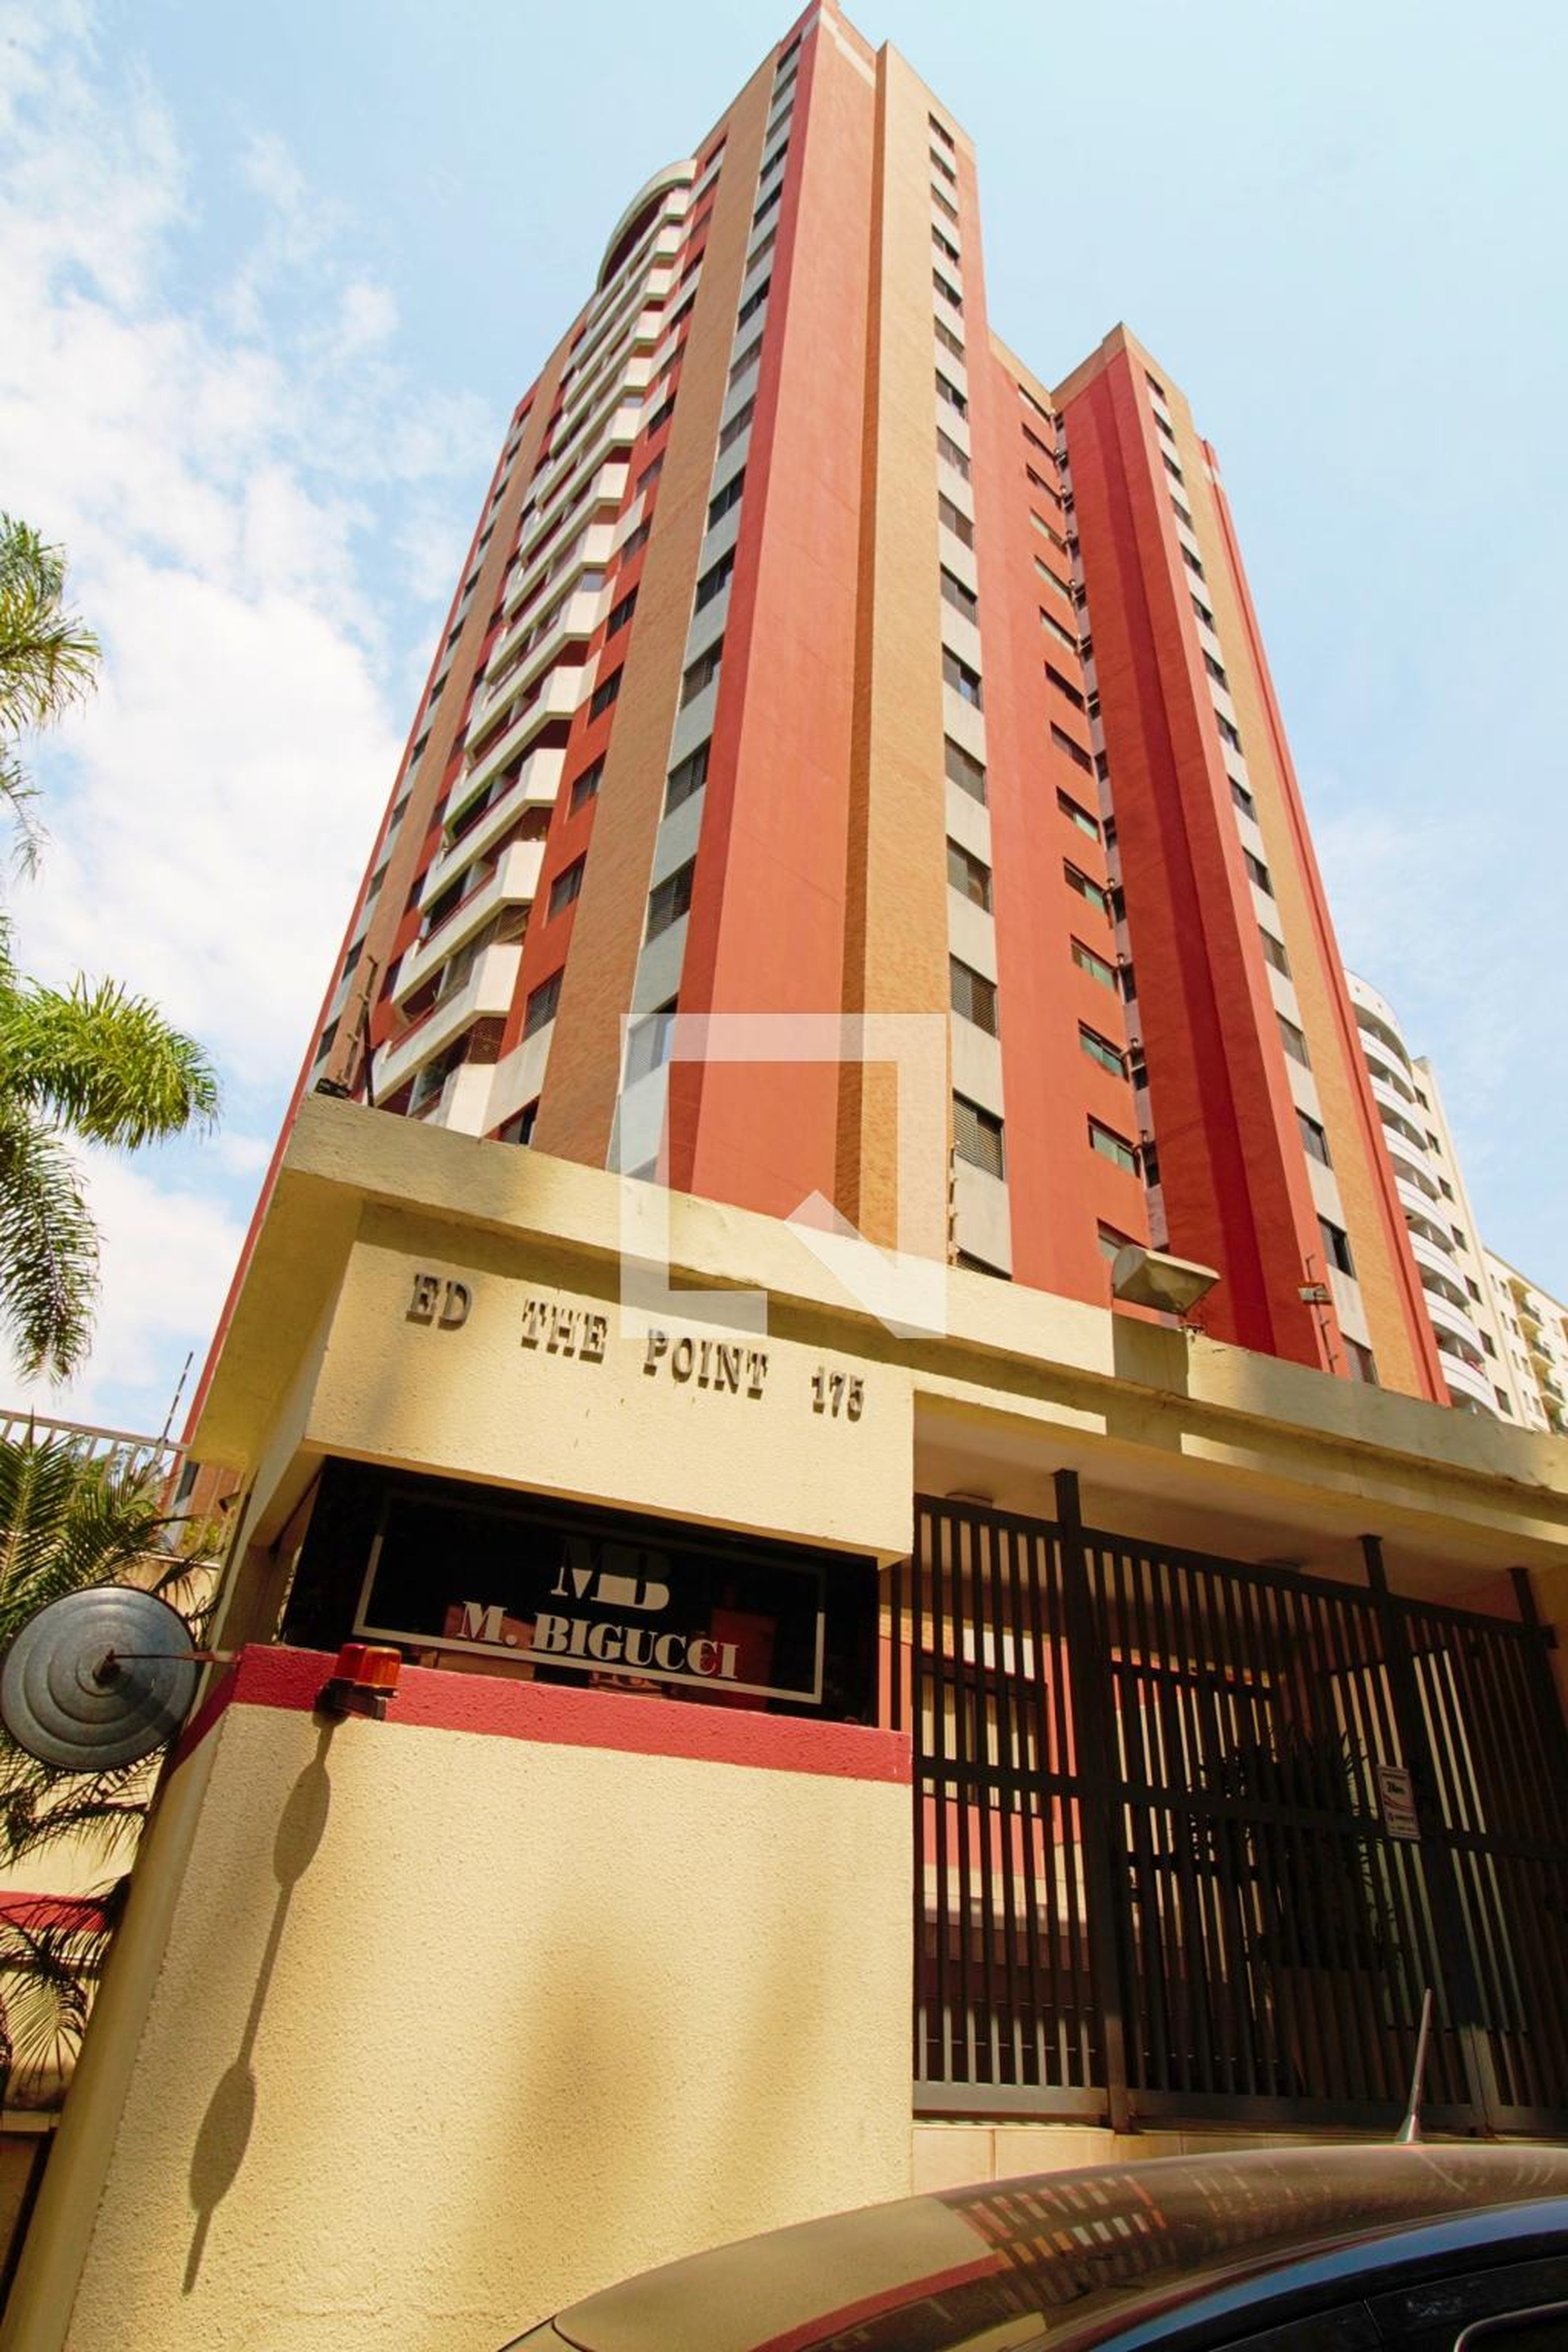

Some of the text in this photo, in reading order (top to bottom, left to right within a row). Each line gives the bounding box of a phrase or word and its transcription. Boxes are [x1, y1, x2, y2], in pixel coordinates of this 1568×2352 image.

[405, 1273, 864, 1422] ED THE POINT 175
[550, 1537, 670, 1610] MB
[457, 1601, 739, 1679] M. BIGUCCI
